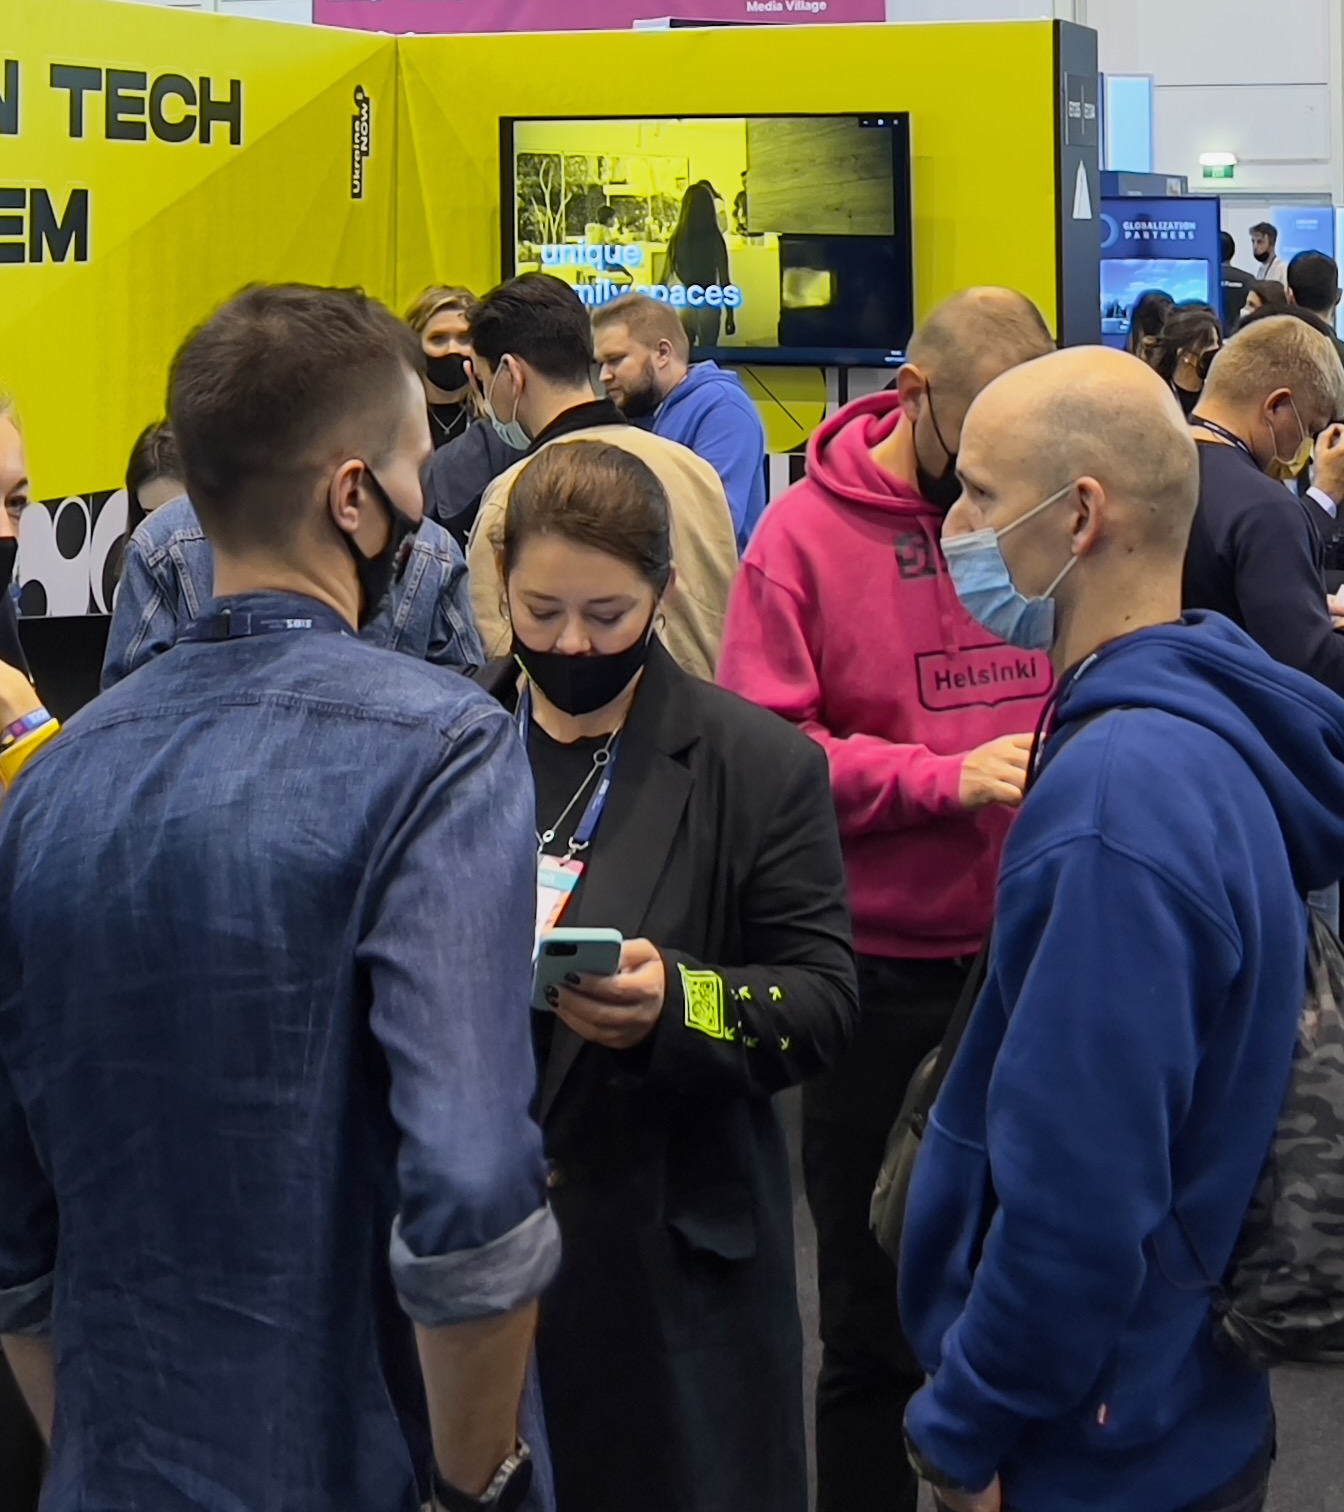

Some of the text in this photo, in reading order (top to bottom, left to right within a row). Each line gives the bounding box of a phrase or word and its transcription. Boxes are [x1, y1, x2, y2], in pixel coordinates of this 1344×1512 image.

[746, 0, 827, 14] Media Village
[49, 62, 242, 146] TECH
[1123, 221, 1196, 231] GLOBALIZATION
[1124, 230, 1195, 240] PARTNERS
[541, 239, 642, 271] unique
[572, 277, 630, 305] mily
[935, 656, 1037, 691] Helsinki
